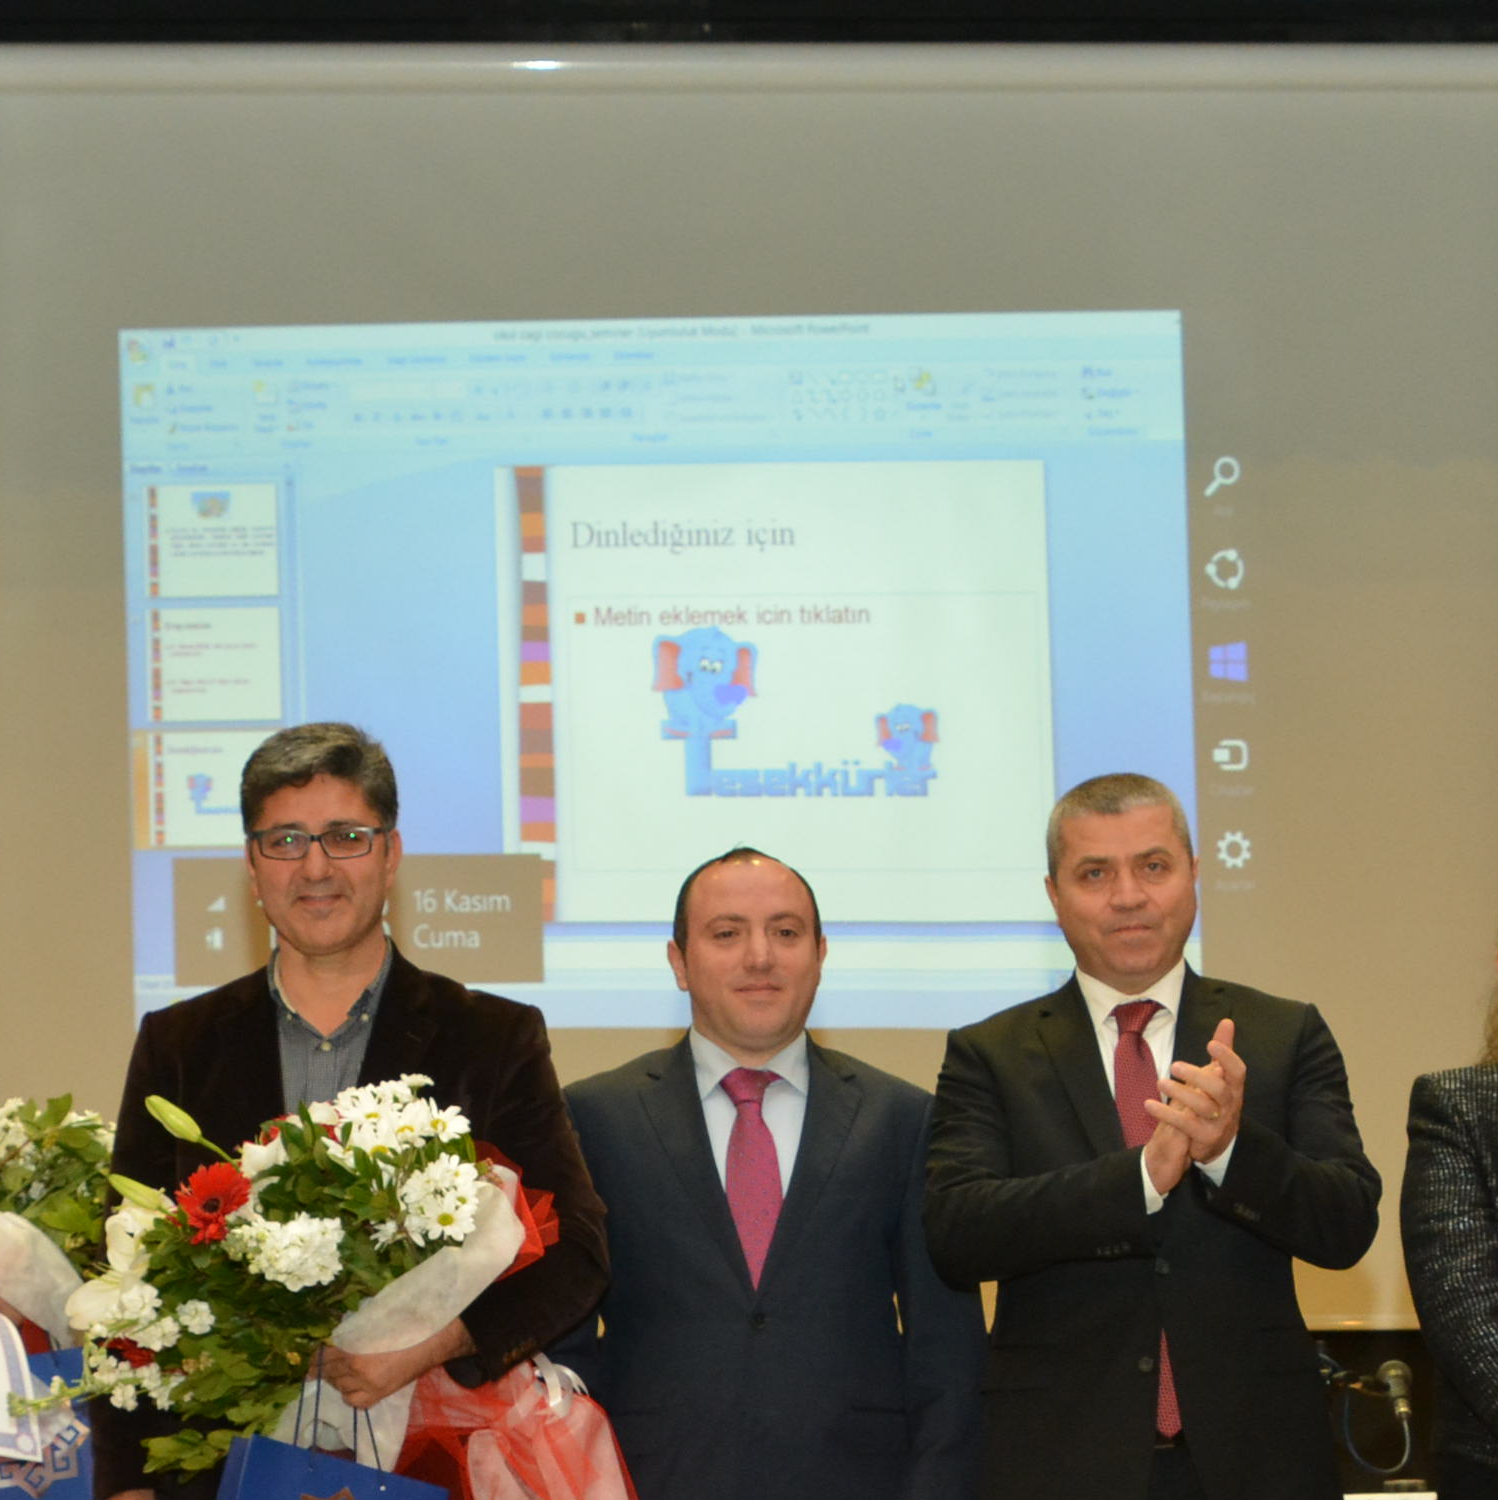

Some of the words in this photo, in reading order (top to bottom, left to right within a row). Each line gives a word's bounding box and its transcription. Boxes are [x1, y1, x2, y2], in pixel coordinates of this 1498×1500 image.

[571, 521, 735, 556] Dinlediğiniz
[746, 521, 796, 554] için
[593, 605, 652, 627] Metin
[659, 604, 747, 626] eklemek
[413, 889, 438, 914] 16
[444, 888, 512, 914] Kasım
[413, 924, 481, 949] Cuma
